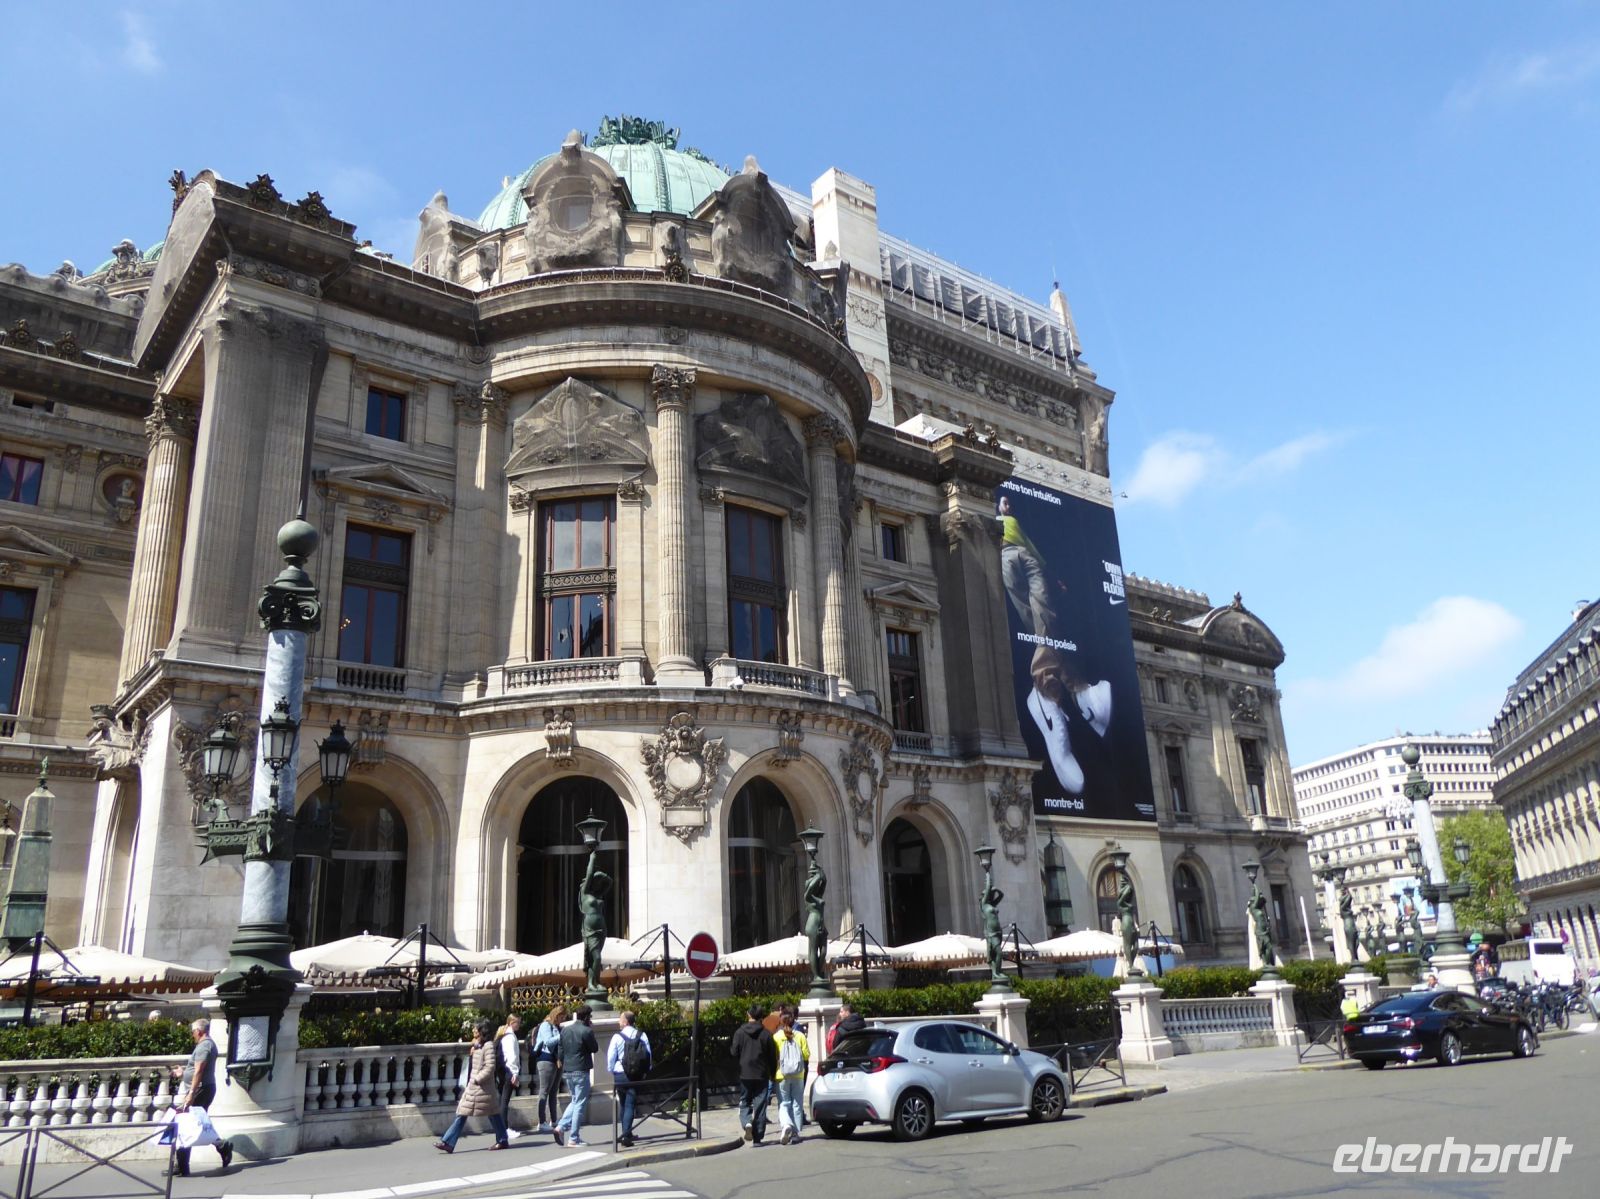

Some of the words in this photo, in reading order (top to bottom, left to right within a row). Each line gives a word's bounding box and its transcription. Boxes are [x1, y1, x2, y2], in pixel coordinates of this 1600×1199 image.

[1020, 484, 1033, 496] ton
[1032, 488, 1061, 505] intuition
[1110, 573, 1124, 587] THE
[1017, 632, 1046, 645] montre
[1045, 635, 1054, 647] ta
[1054, 639, 1077, 652] poésie
[1044, 797, 1085, 810] montre-toi
